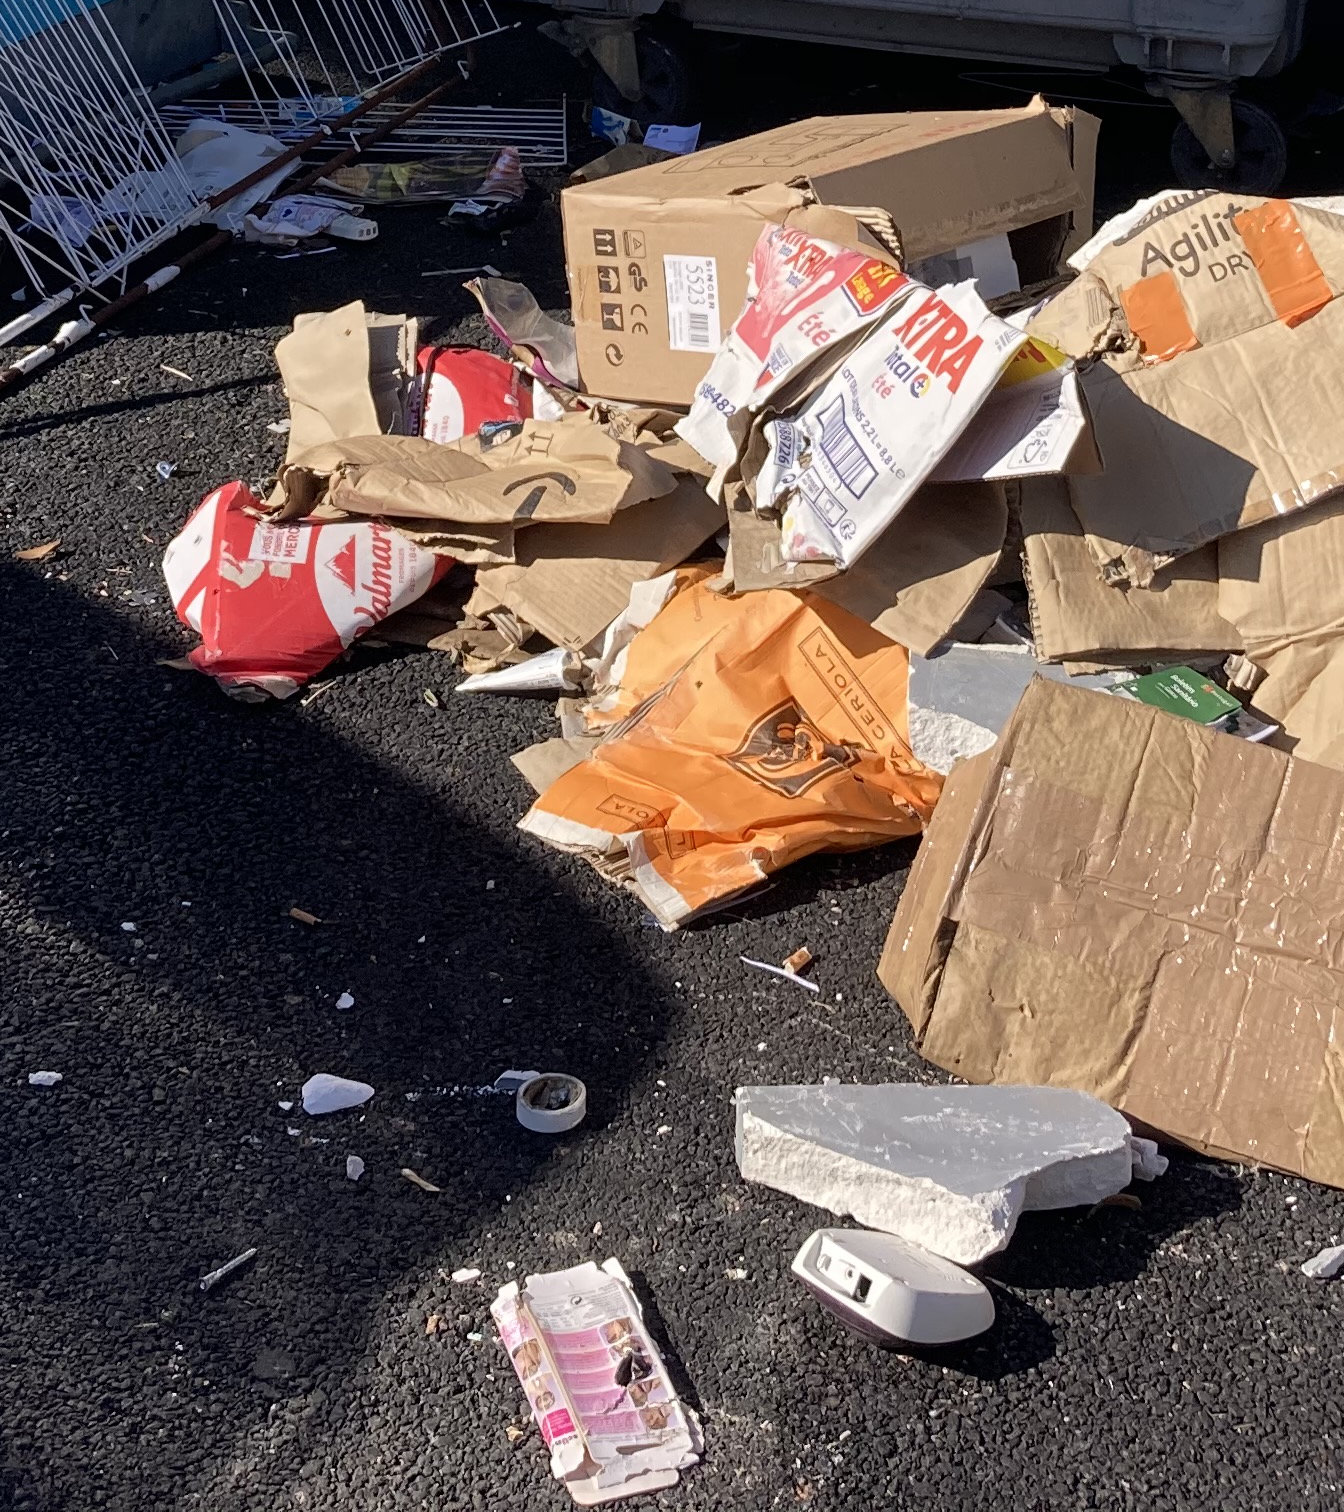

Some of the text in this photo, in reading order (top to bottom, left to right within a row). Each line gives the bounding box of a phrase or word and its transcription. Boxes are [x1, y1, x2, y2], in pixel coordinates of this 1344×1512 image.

[1141, 201, 1253, 279] Agilit
[686, 263, 706, 306] 5523
[704, 260, 716, 310] SINGER
[796, 310, 837, 348] Été
[883, 344, 917, 383] Total
[871, 372, 894, 400] Été
[814, 642, 887, 741] CERIOLA
